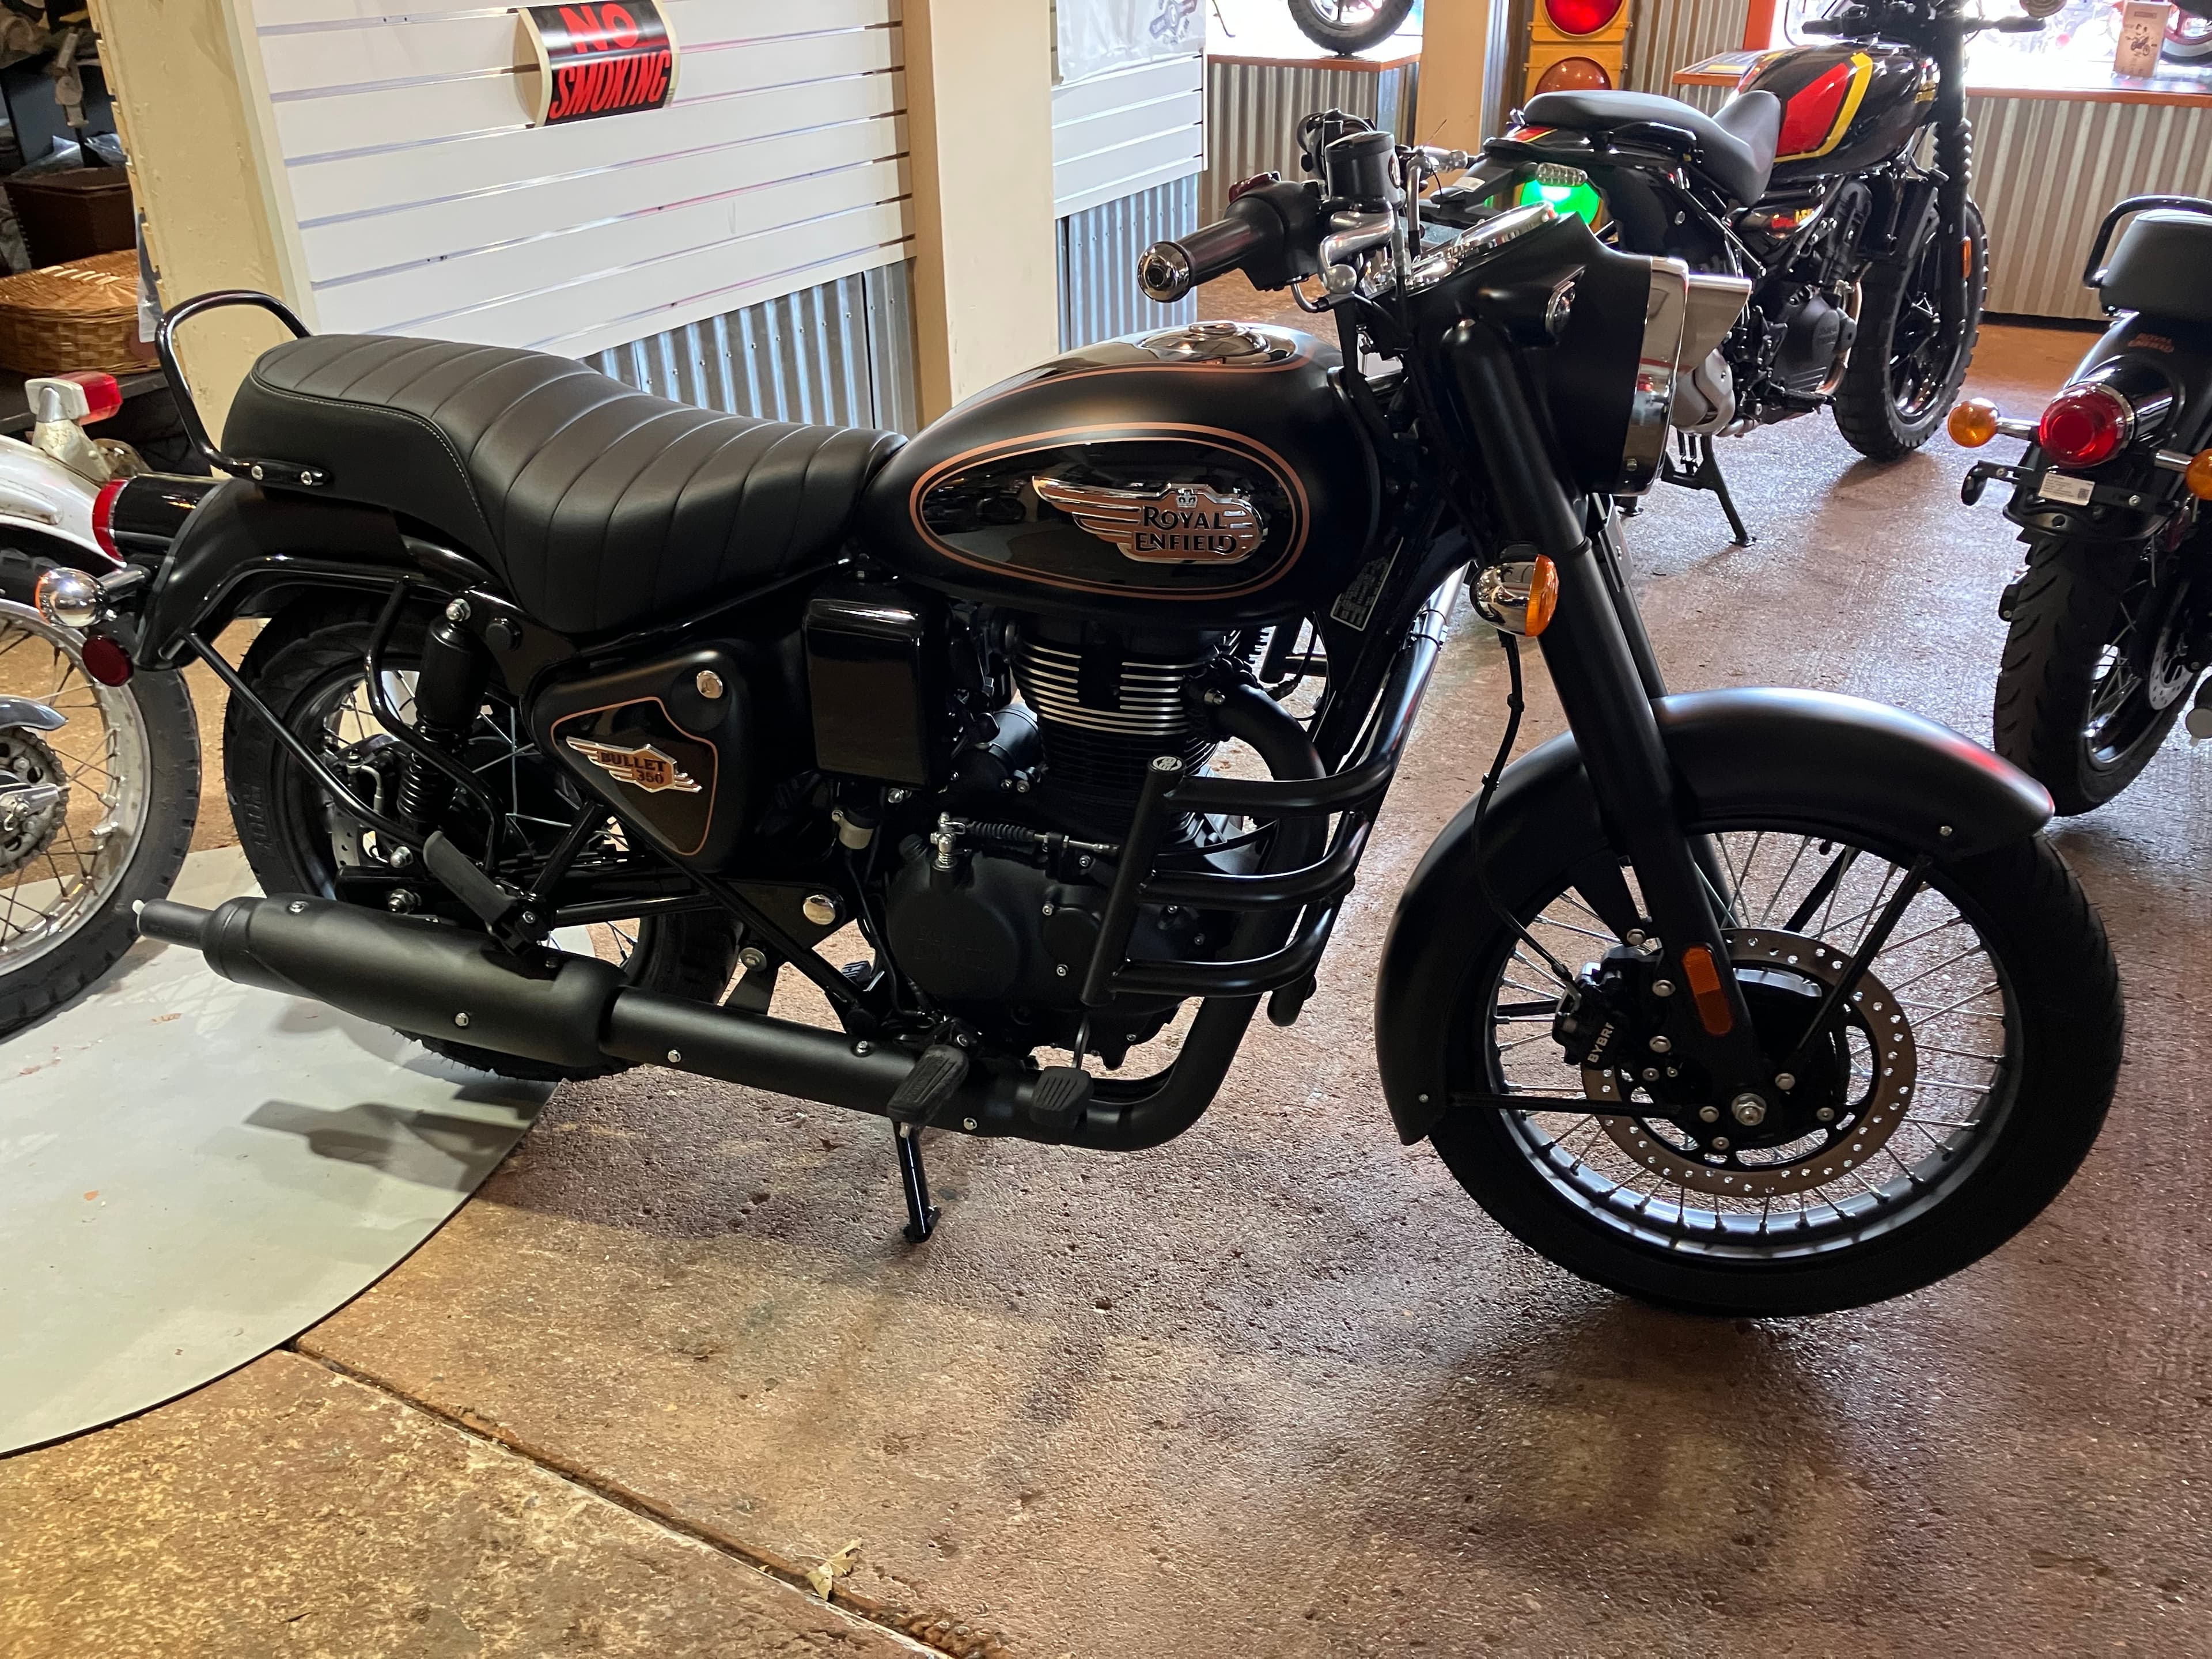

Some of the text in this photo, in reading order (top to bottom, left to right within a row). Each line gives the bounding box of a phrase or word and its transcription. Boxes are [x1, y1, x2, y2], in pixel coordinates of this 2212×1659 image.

[559, 3, 639, 54] NO
[549, 50, 671, 120] SMOKING
[1143, 506, 1228, 531] ROYAL
[1135, 532, 1237, 555] ENFIELD
[601, 752, 666, 772] BULLET
[637, 769, 665, 785] 350
